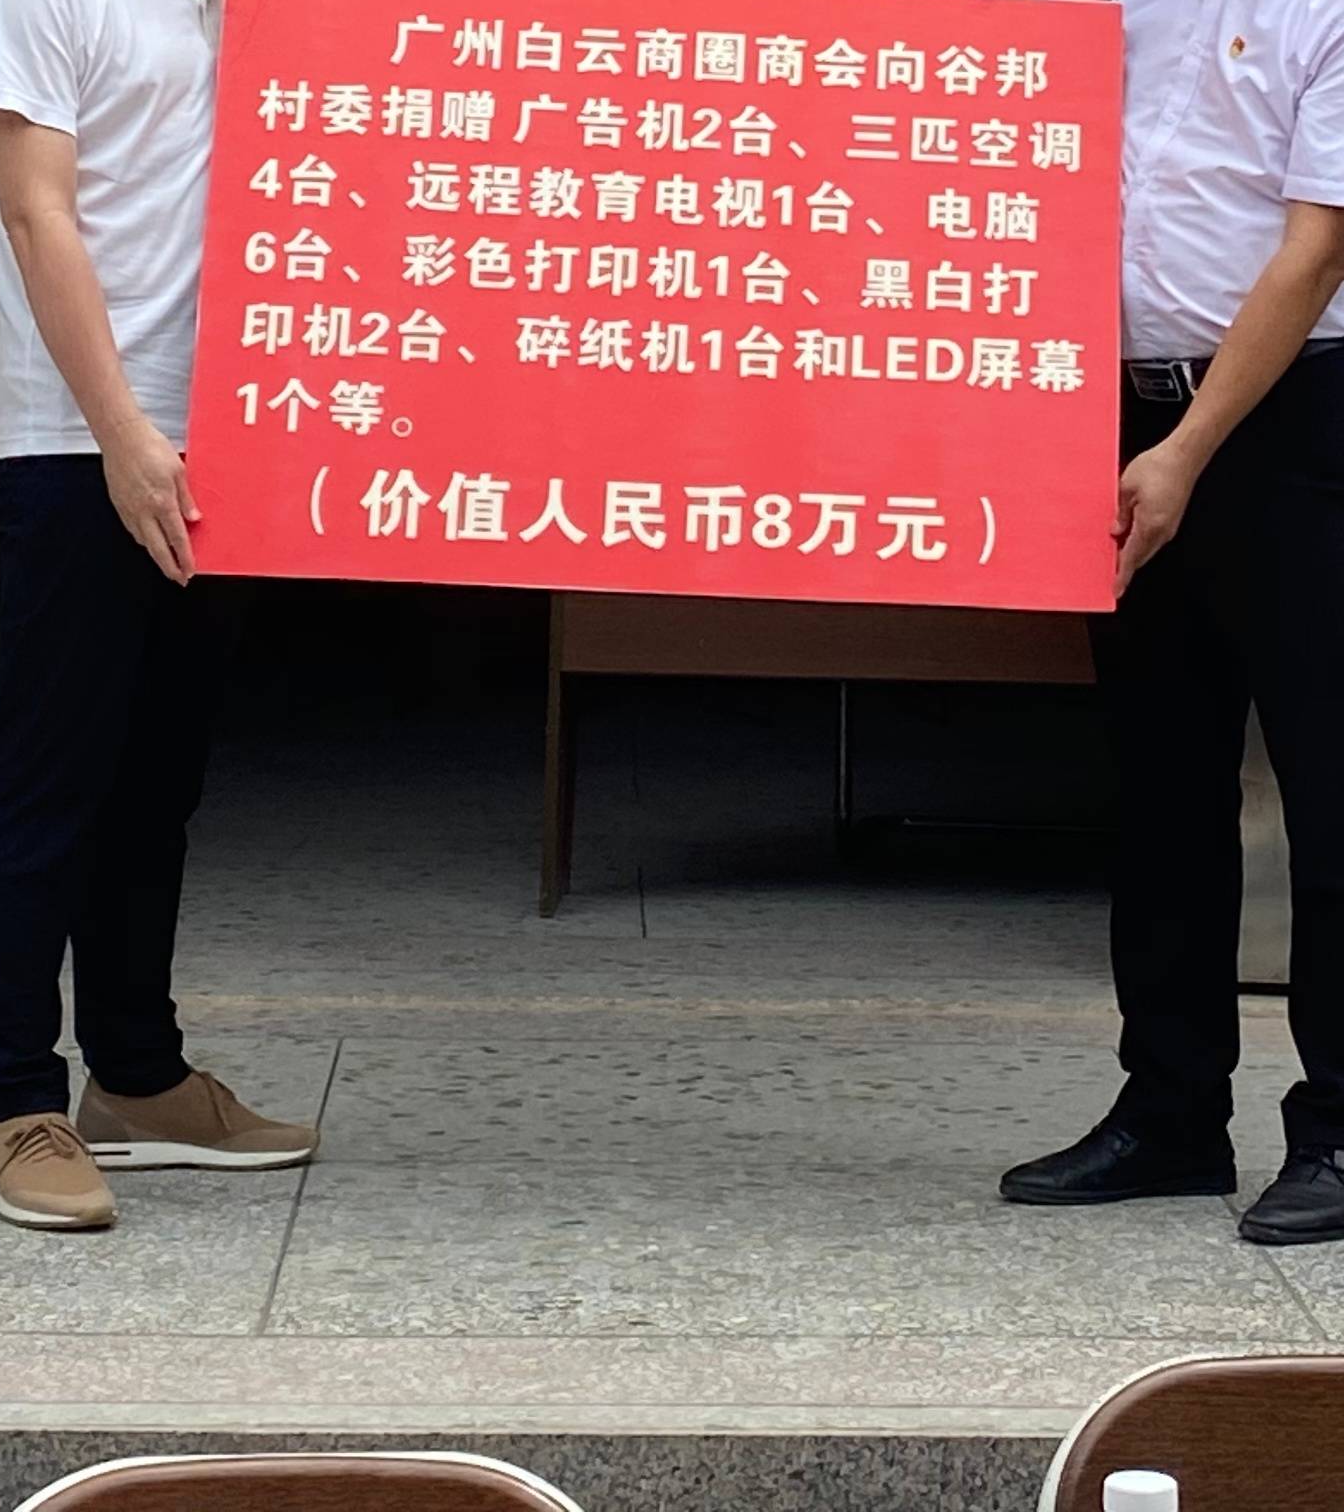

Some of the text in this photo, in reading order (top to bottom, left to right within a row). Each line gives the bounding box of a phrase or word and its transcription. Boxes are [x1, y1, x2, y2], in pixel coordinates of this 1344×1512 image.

[392, 15, 1049, 99] 广州白云商圈商会向谷邦
[249, 154, 1040, 243] 4台、远程教育电视1台、电脑
[244, 229, 1039, 318] 6台、彩色打印机1台、黑白打
[239, 303, 1086, 394] 印机2台、碎纸机1台和LED屏幕
[236, 377, 413, 440] 1个等。
